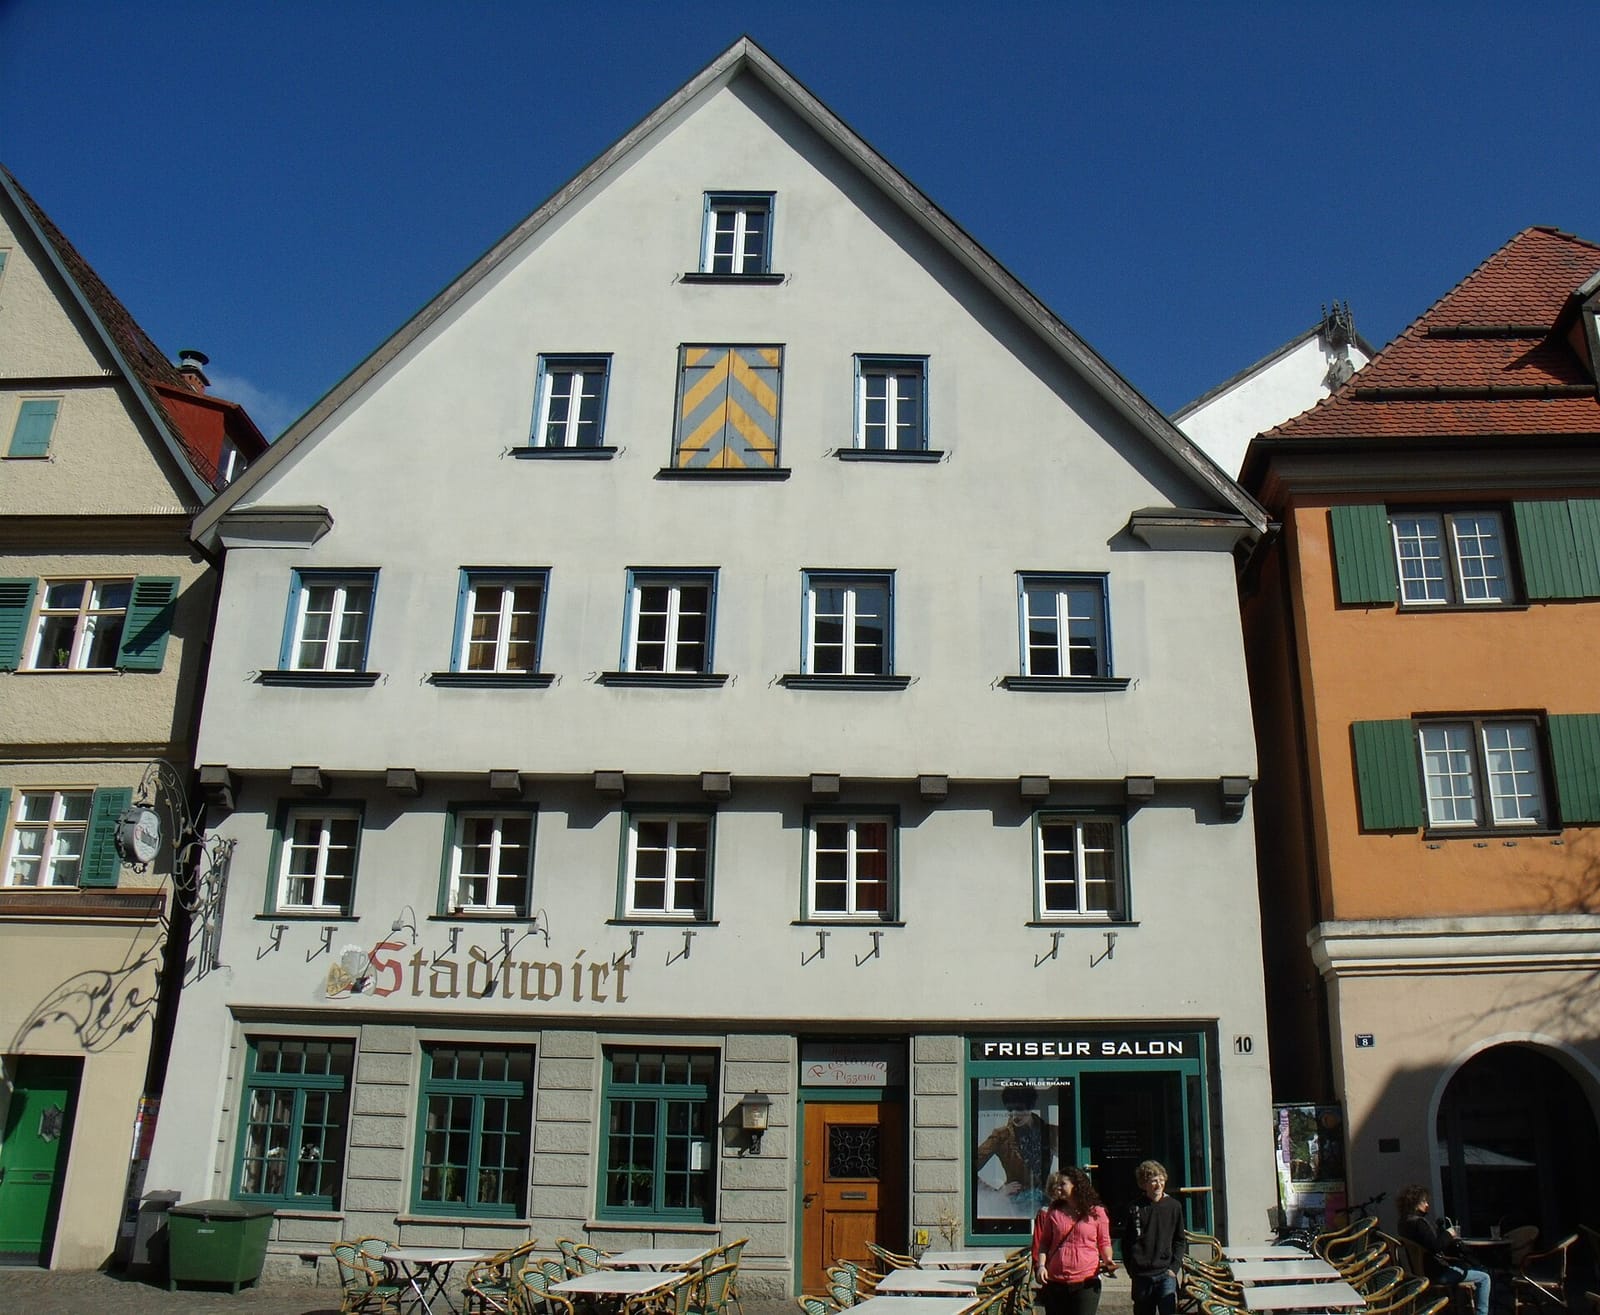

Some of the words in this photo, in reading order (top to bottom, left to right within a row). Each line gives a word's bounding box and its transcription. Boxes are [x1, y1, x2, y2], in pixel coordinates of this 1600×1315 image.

[367, 941, 631, 1003] Stadtwirt
[984, 1041, 1091, 1056] FRISEUR
[1101, 1041, 1183, 1055] SALON
[1235, 1036, 1252, 1053] 10
[1362, 1038, 1369, 1047] 8
